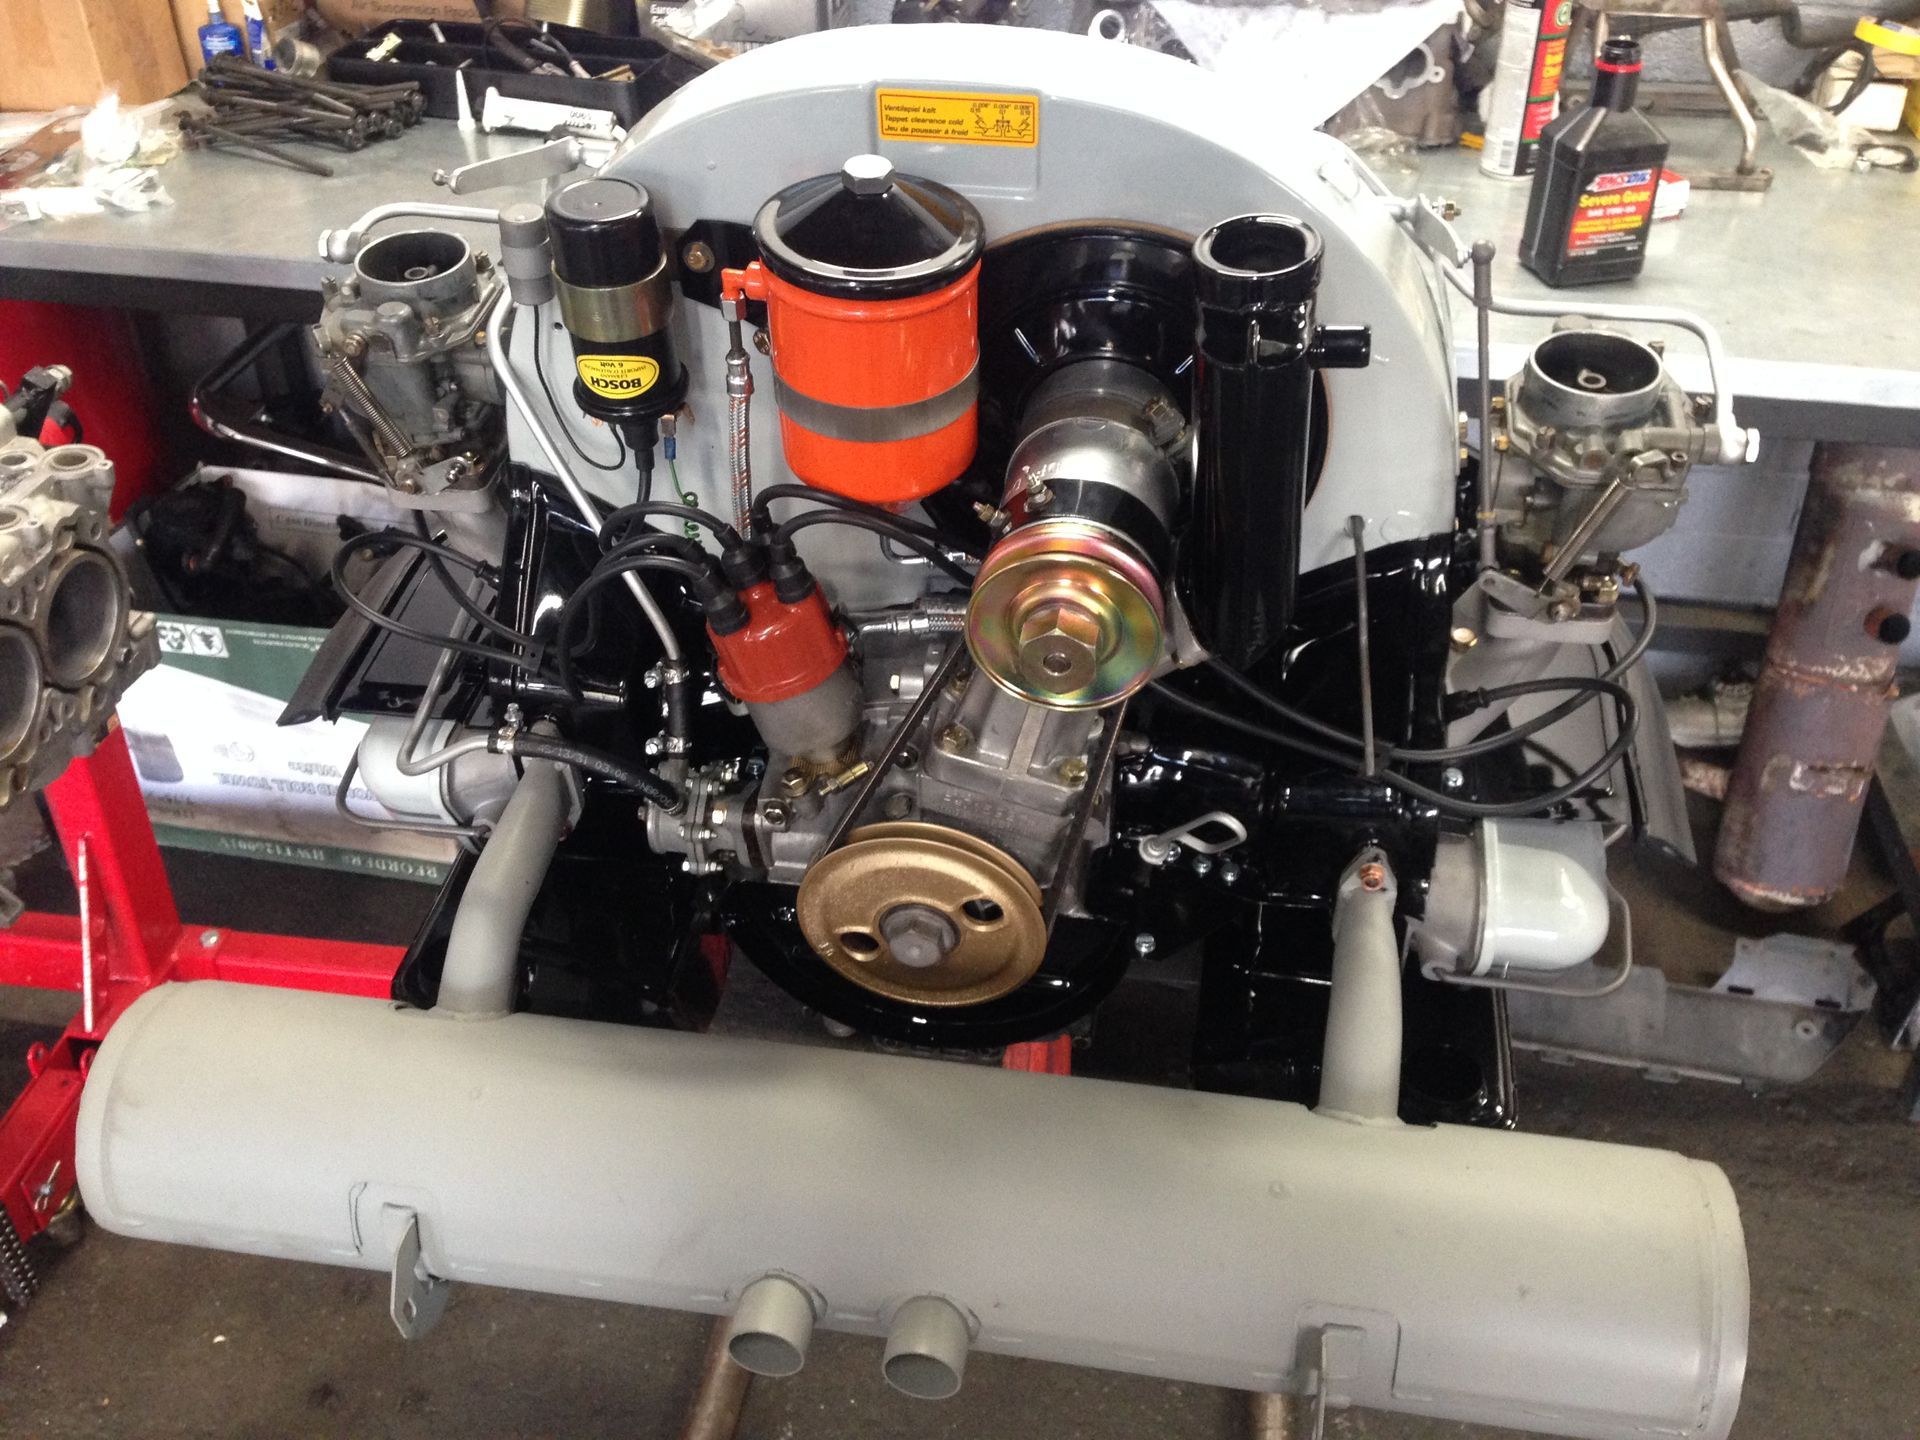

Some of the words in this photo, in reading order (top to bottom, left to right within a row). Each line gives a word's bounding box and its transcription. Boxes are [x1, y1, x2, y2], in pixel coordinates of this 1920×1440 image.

[922, 106, 936, 114] kalt
[884, 115, 908, 123] Tappet
[911, 116, 946, 124] clearance
[1579, 195, 1621, 208] Severe
[1622, 191, 1650, 203] Gear
[591, 376, 642, 390] BOSCH
[288, 760, 342, 778] White
[214, 772, 271, 790] TOWEL
[271, 778, 317, 795] ROLL
